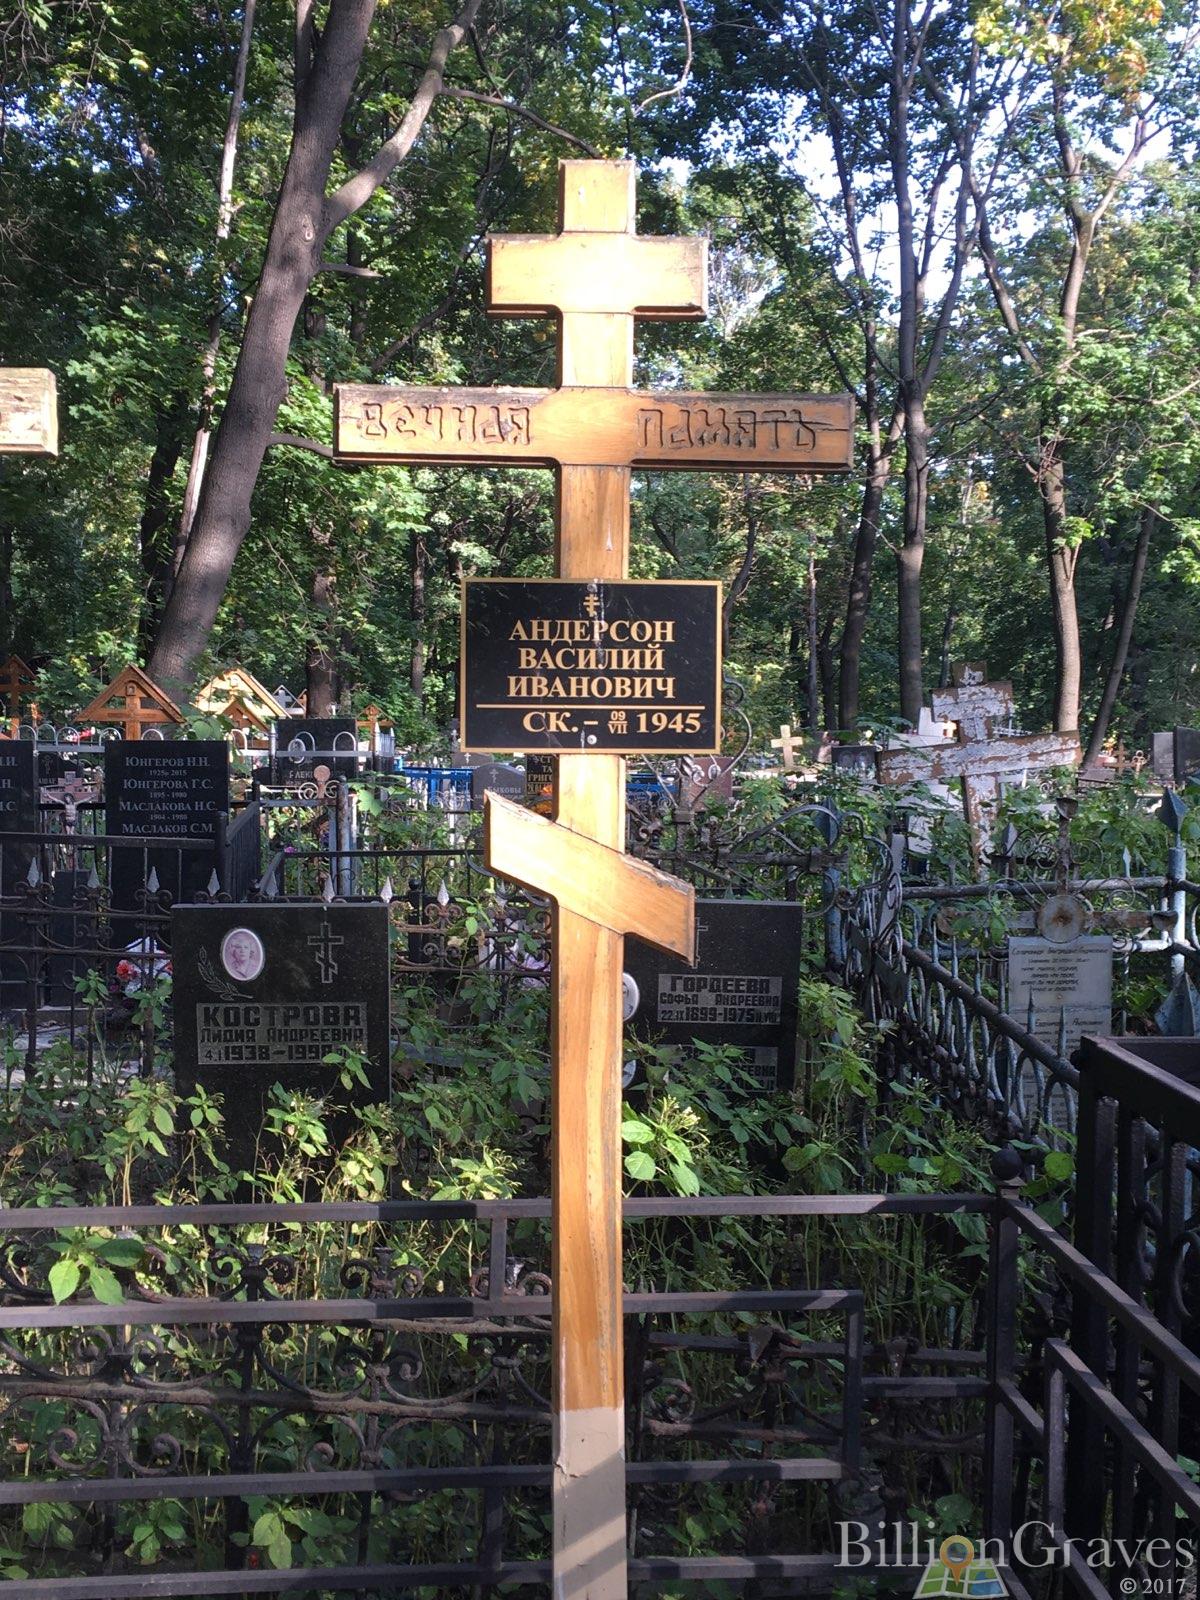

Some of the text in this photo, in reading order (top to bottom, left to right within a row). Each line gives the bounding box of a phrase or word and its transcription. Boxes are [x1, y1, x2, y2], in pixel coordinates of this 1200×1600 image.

[508, 619, 675, 646] АНДЕРСОН
[518, 644, 665, 671] ВАСИЛИЙ
[507, 676, 676, 699] ИВАНОВИЧ
[522, 711, 579, 733] СК.
[636, 712, 701, 734] 1945
[203, 1005, 361, 1027] КОСТРОВА
